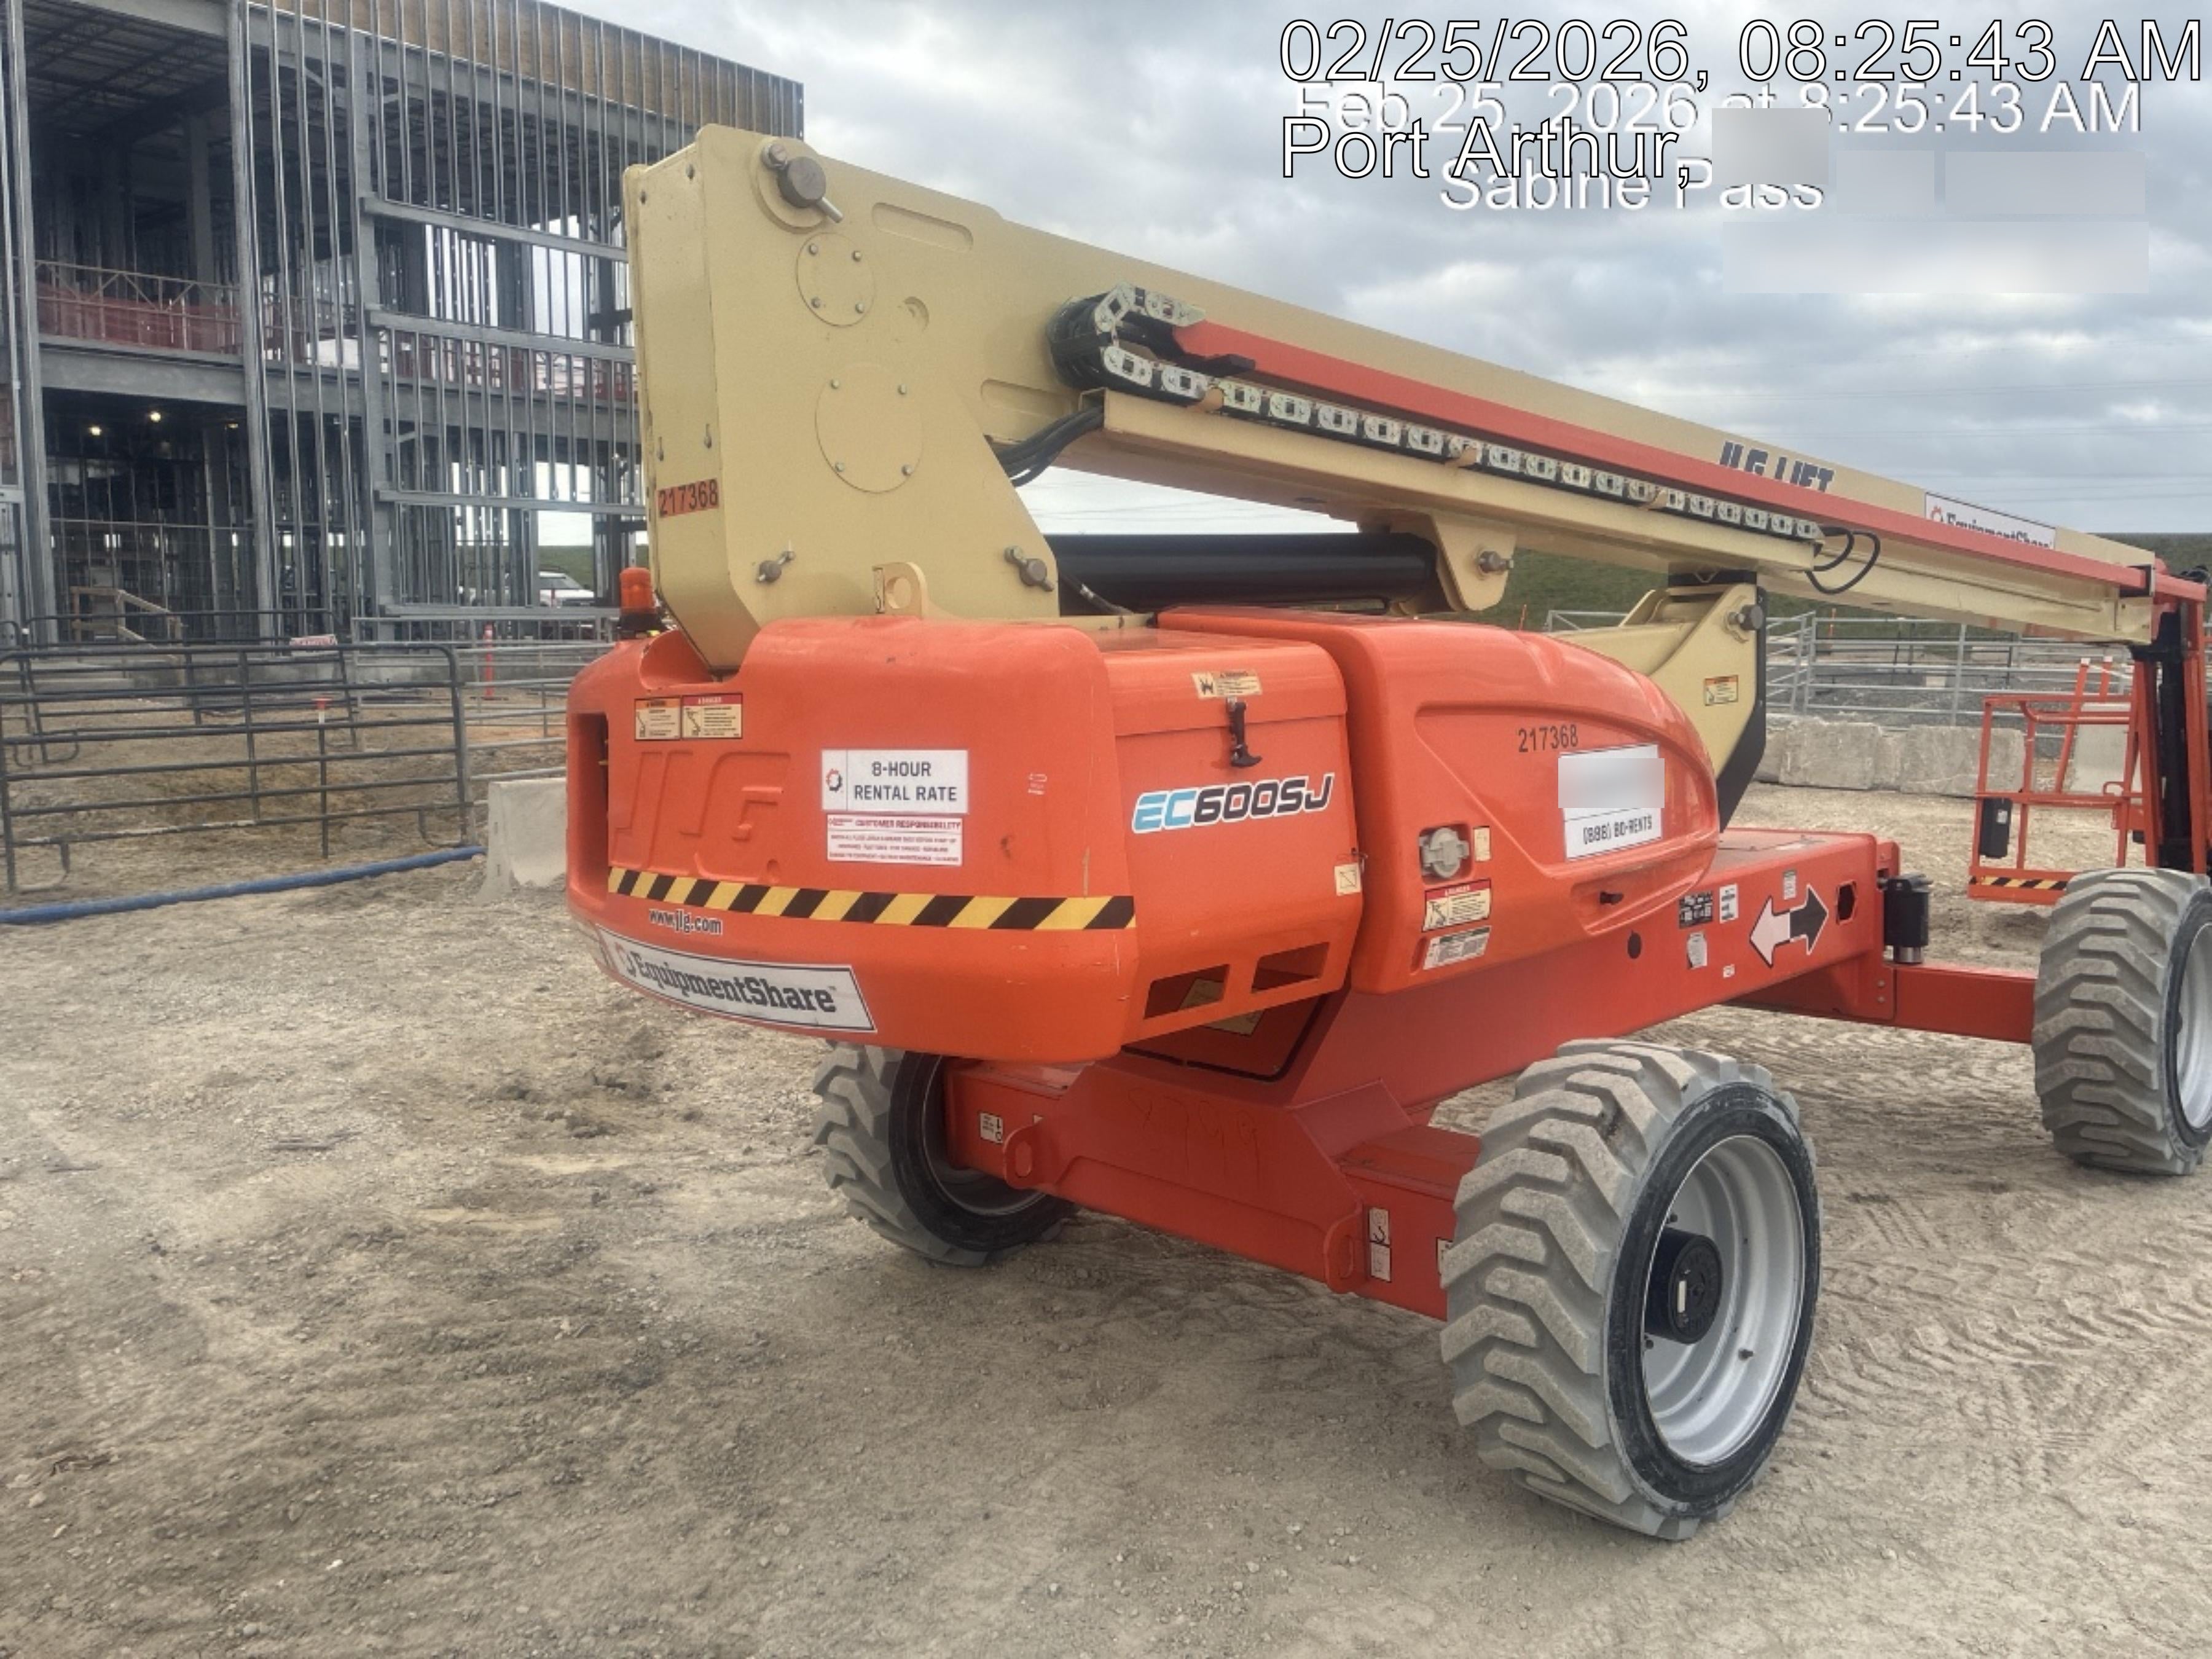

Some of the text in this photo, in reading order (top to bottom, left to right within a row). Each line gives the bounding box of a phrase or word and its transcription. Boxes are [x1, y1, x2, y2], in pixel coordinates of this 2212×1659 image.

[659, 479, 719, 518] 217368
[1518, 724, 1579, 753] 217368
[871, 761, 932, 777] 8-HOUR
[854, 784, 958, 802] RENTAL RATE
[1134, 773, 1335, 833] EC600SJ
[648, 909, 724, 935] www.jlg.com
